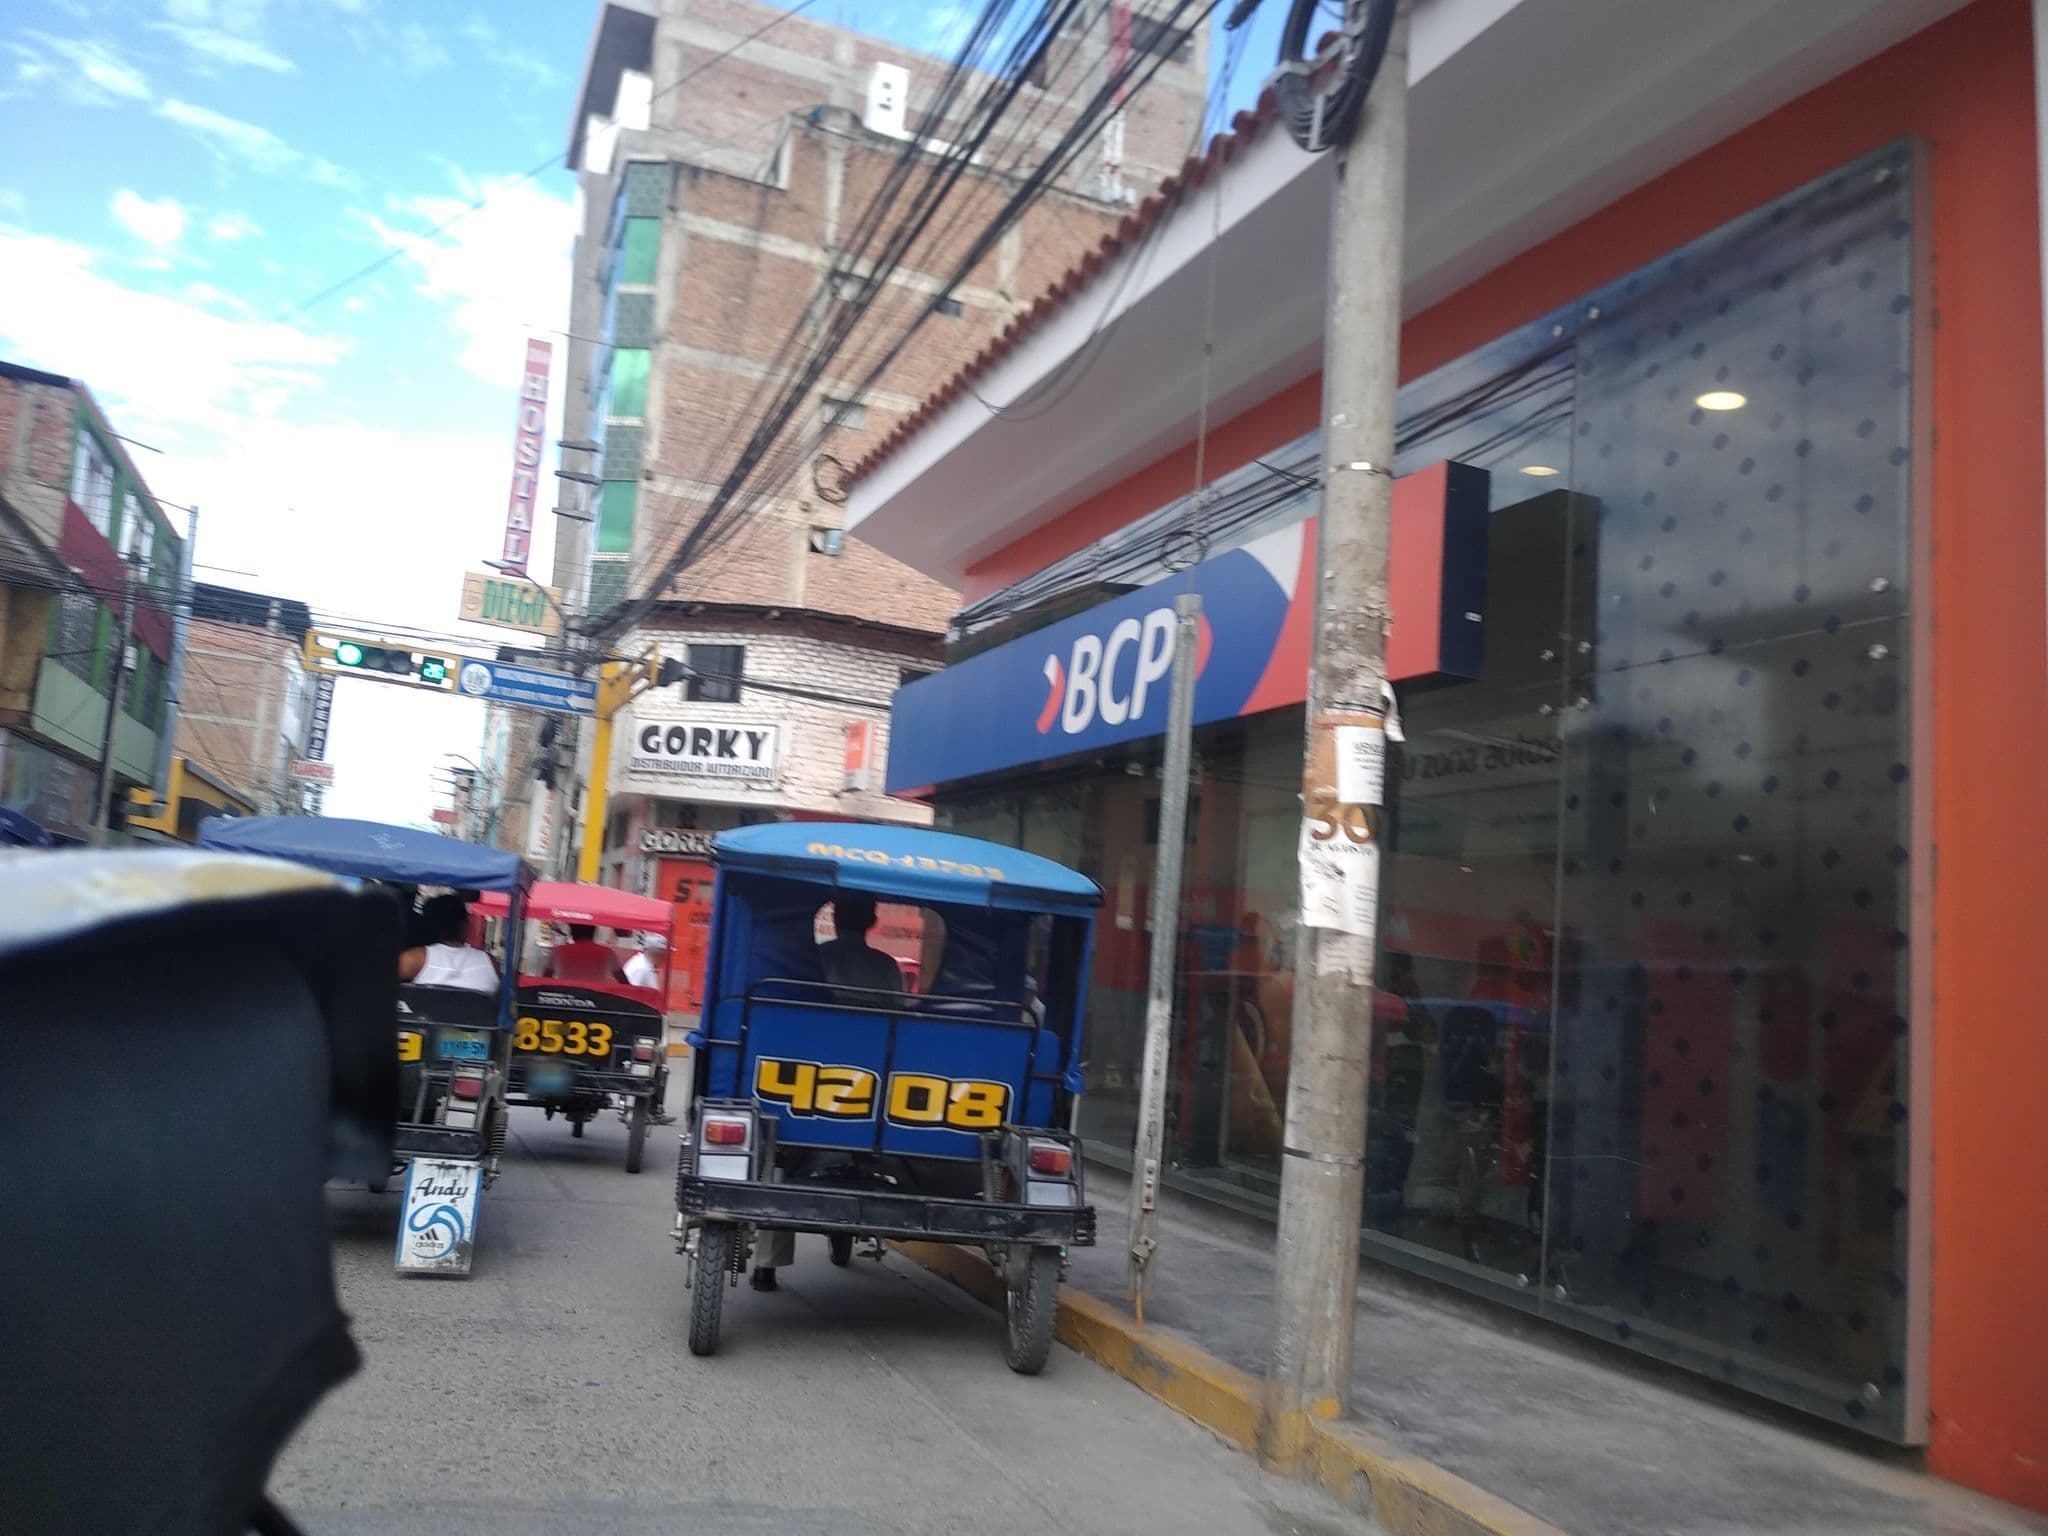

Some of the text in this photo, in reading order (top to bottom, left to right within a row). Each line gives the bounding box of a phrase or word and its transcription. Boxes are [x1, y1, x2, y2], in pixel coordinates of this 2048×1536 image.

[504, 374, 549, 562] HOSTAL
[482, 578, 546, 628] DIEGO
[1062, 607, 1178, 734] BCP
[641, 725, 769, 760] GORKY
[538, 996, 597, 1008] HONDA
[514, 1017, 613, 1056] 8533
[416, 1177, 469, 1203] Andy
